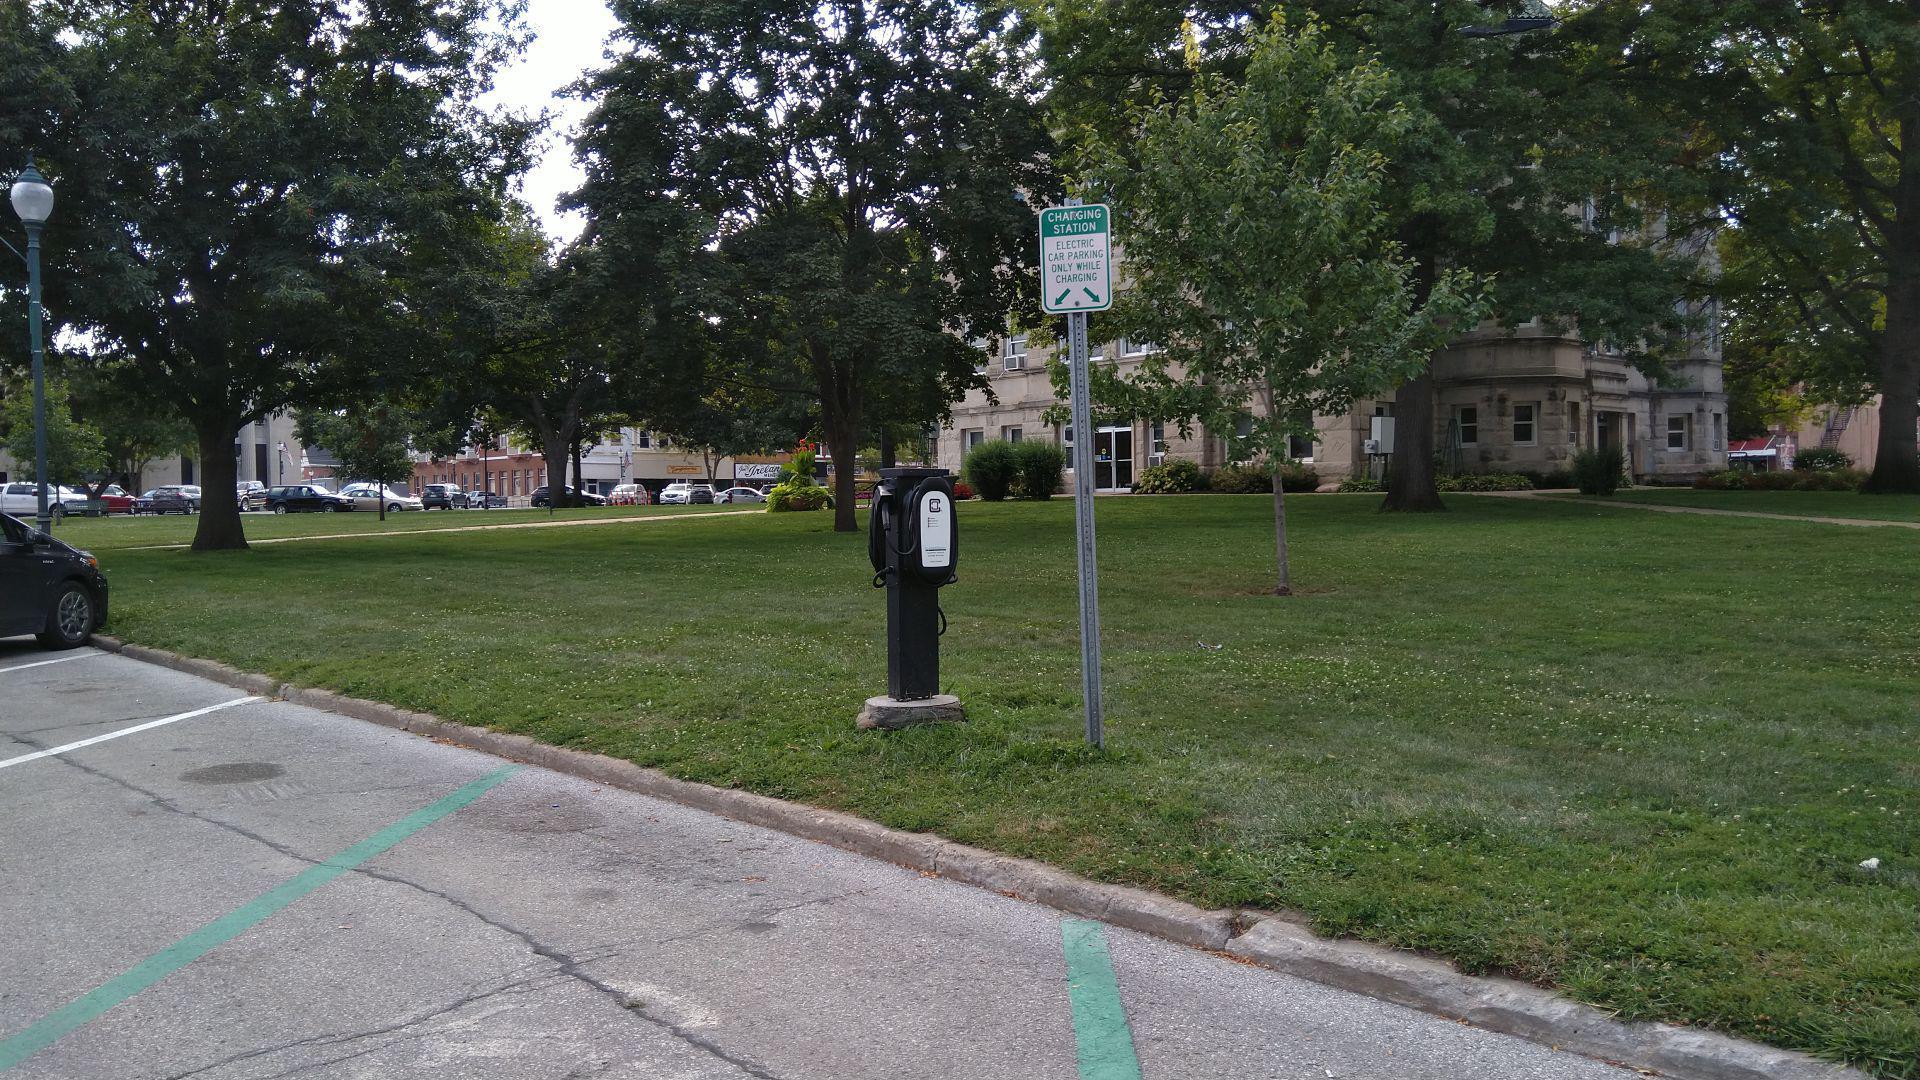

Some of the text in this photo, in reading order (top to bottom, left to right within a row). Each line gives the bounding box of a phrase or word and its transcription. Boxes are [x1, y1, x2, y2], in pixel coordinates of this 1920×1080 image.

[1047, 209, 1101, 222] CHARGING
[1053, 222, 1096, 234] STATION
[1056, 239, 1094, 250] ELECTRIC
[1048, 249, 1103, 261] CAR PARKING
[1051, 261, 1101, 272] ONLY WHILE
[1056, 273, 1097, 283] CHARGING
